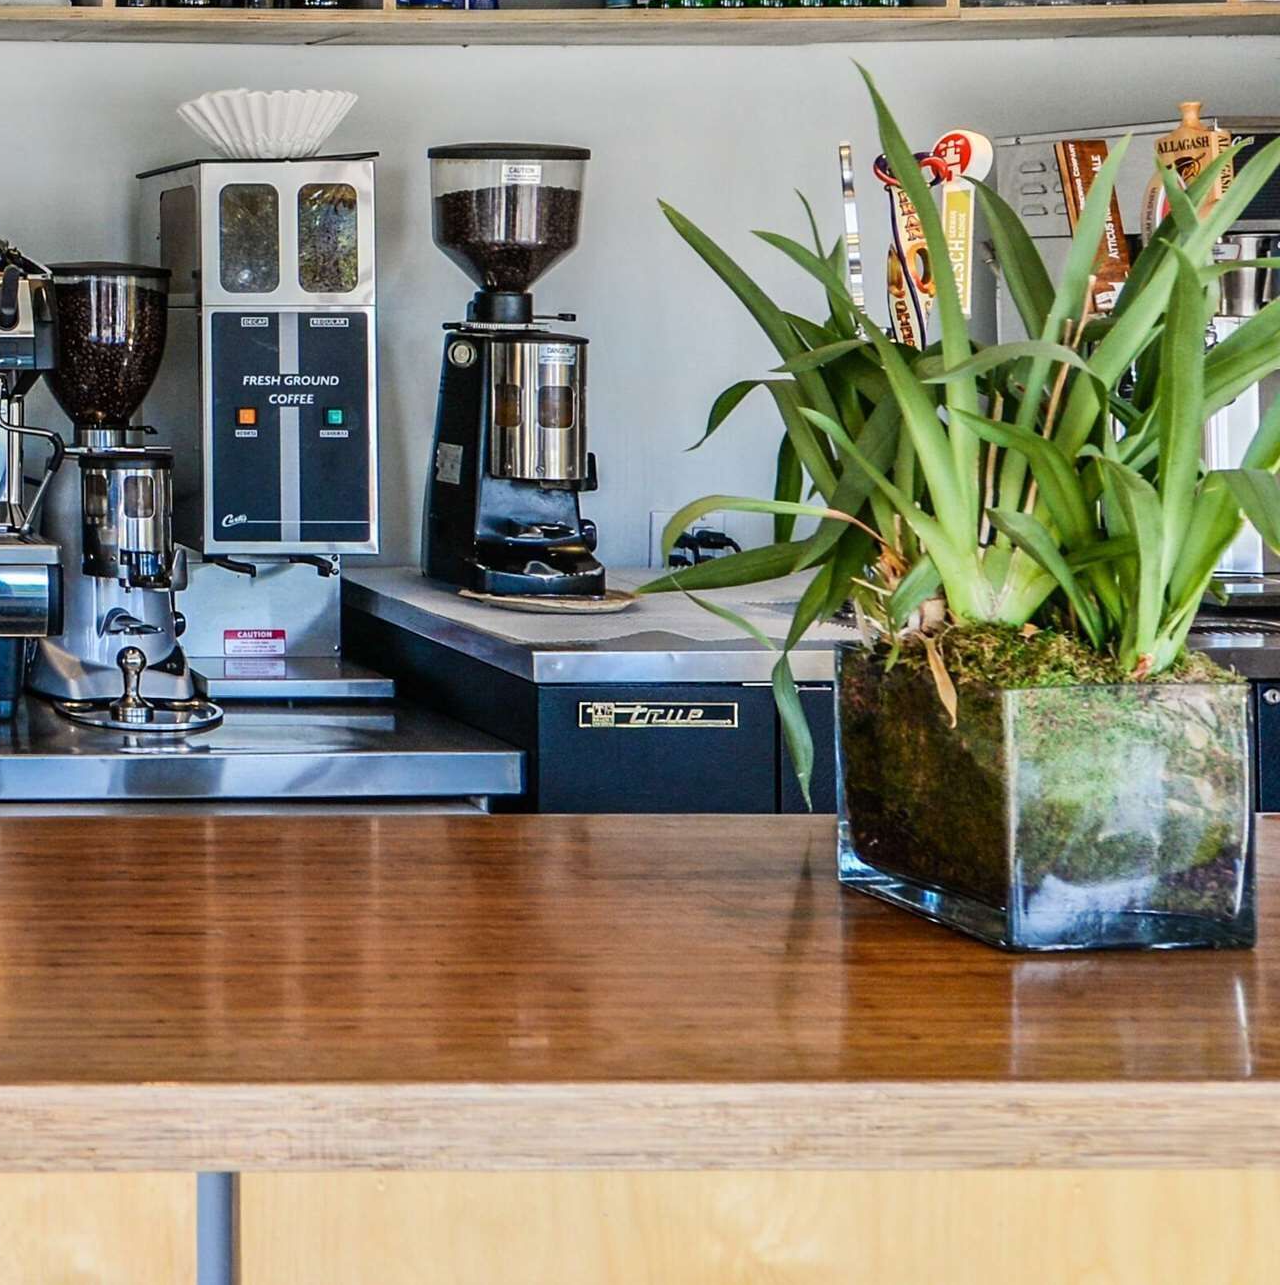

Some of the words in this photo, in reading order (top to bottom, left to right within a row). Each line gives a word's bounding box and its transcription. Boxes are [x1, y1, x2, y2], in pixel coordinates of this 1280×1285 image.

[1157, 135, 1210, 154] ALLAGASH
[1105, 221, 1120, 259] ATTICUS
[243, 375, 280, 386] FRESH
[284, 375, 340, 386] GROUND
[268, 393, 314, 404] COFFEE
